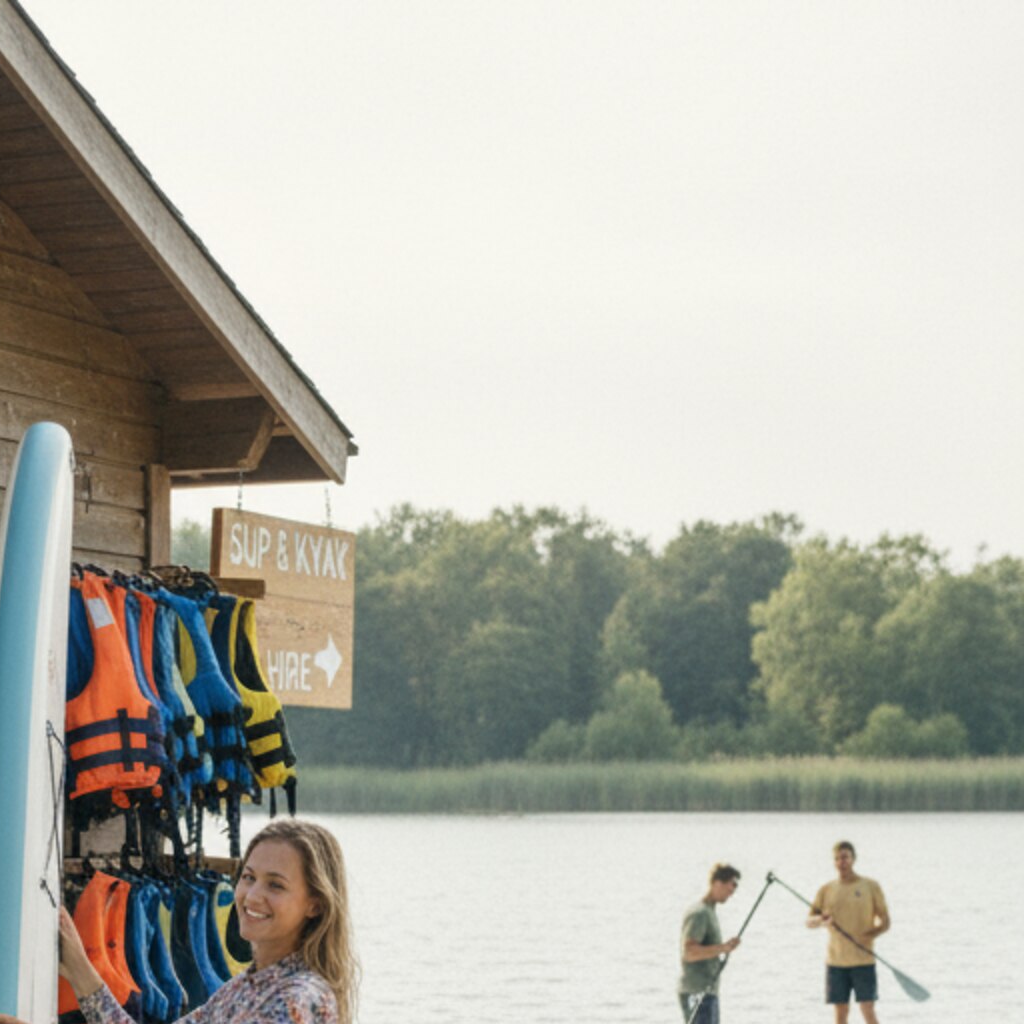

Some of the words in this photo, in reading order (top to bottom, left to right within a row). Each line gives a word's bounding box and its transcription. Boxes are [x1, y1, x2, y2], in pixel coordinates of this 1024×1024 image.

[229, 522, 271, 569] SUP
[277, 529, 290, 572] &
[294, 530, 350, 581] KYAK
